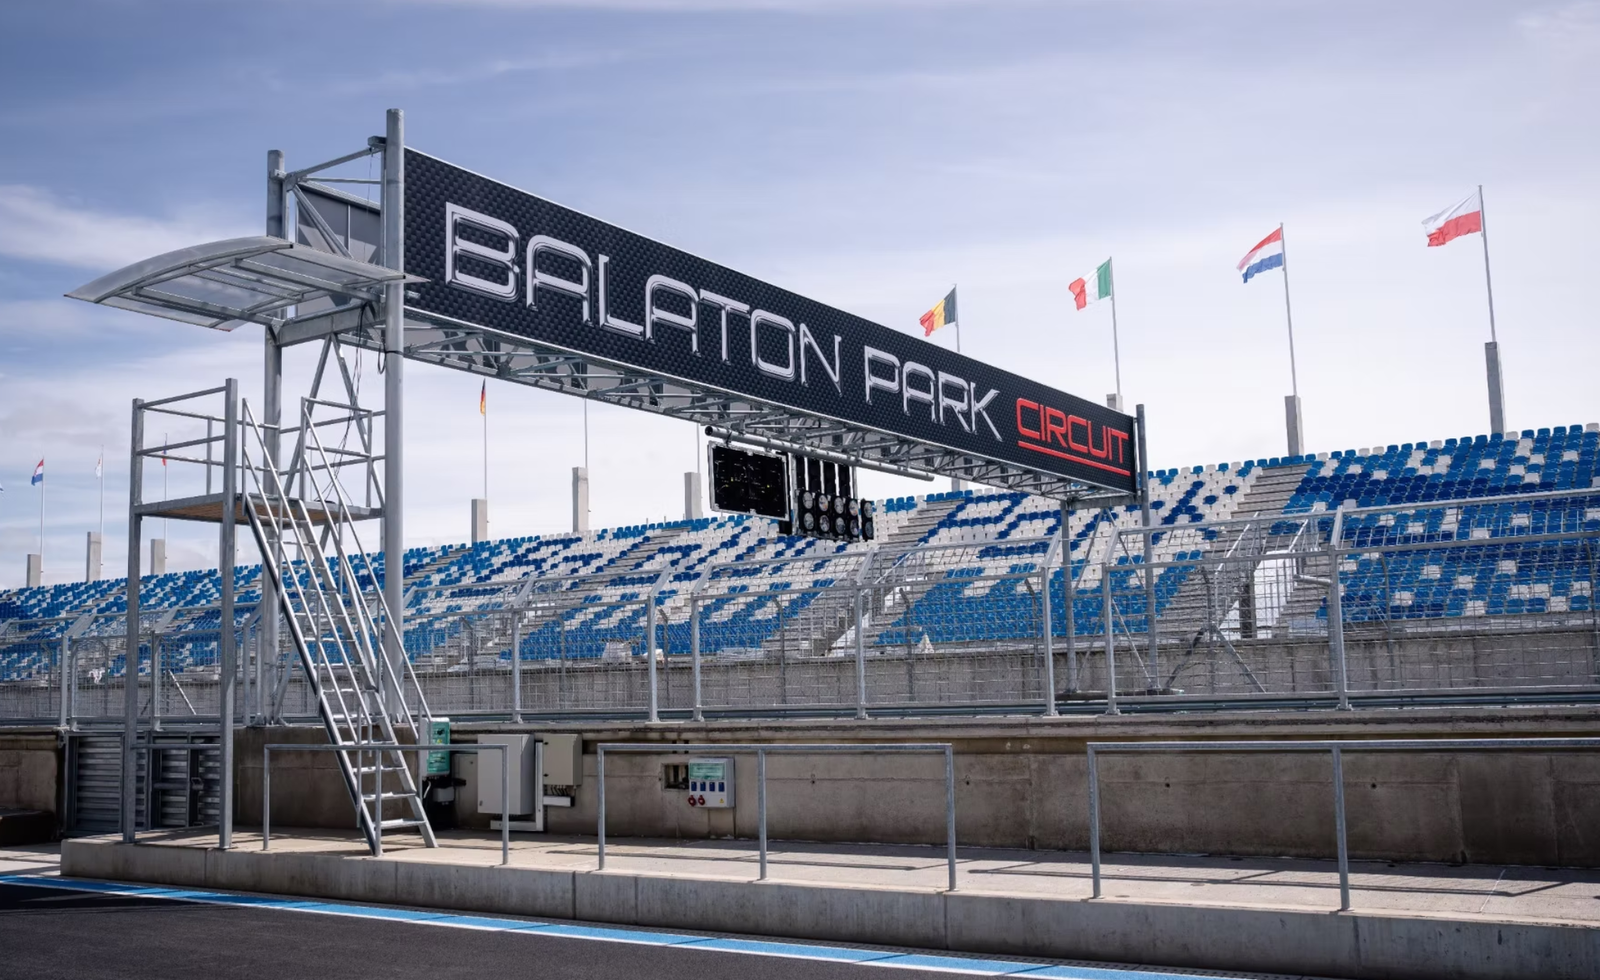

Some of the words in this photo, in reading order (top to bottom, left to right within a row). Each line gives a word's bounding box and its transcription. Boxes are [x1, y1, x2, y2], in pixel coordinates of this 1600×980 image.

[445, 201, 843, 397] BALATON
[864, 345, 1003, 441] PARK
[1016, 397, 1129, 464] CIRCUIT
